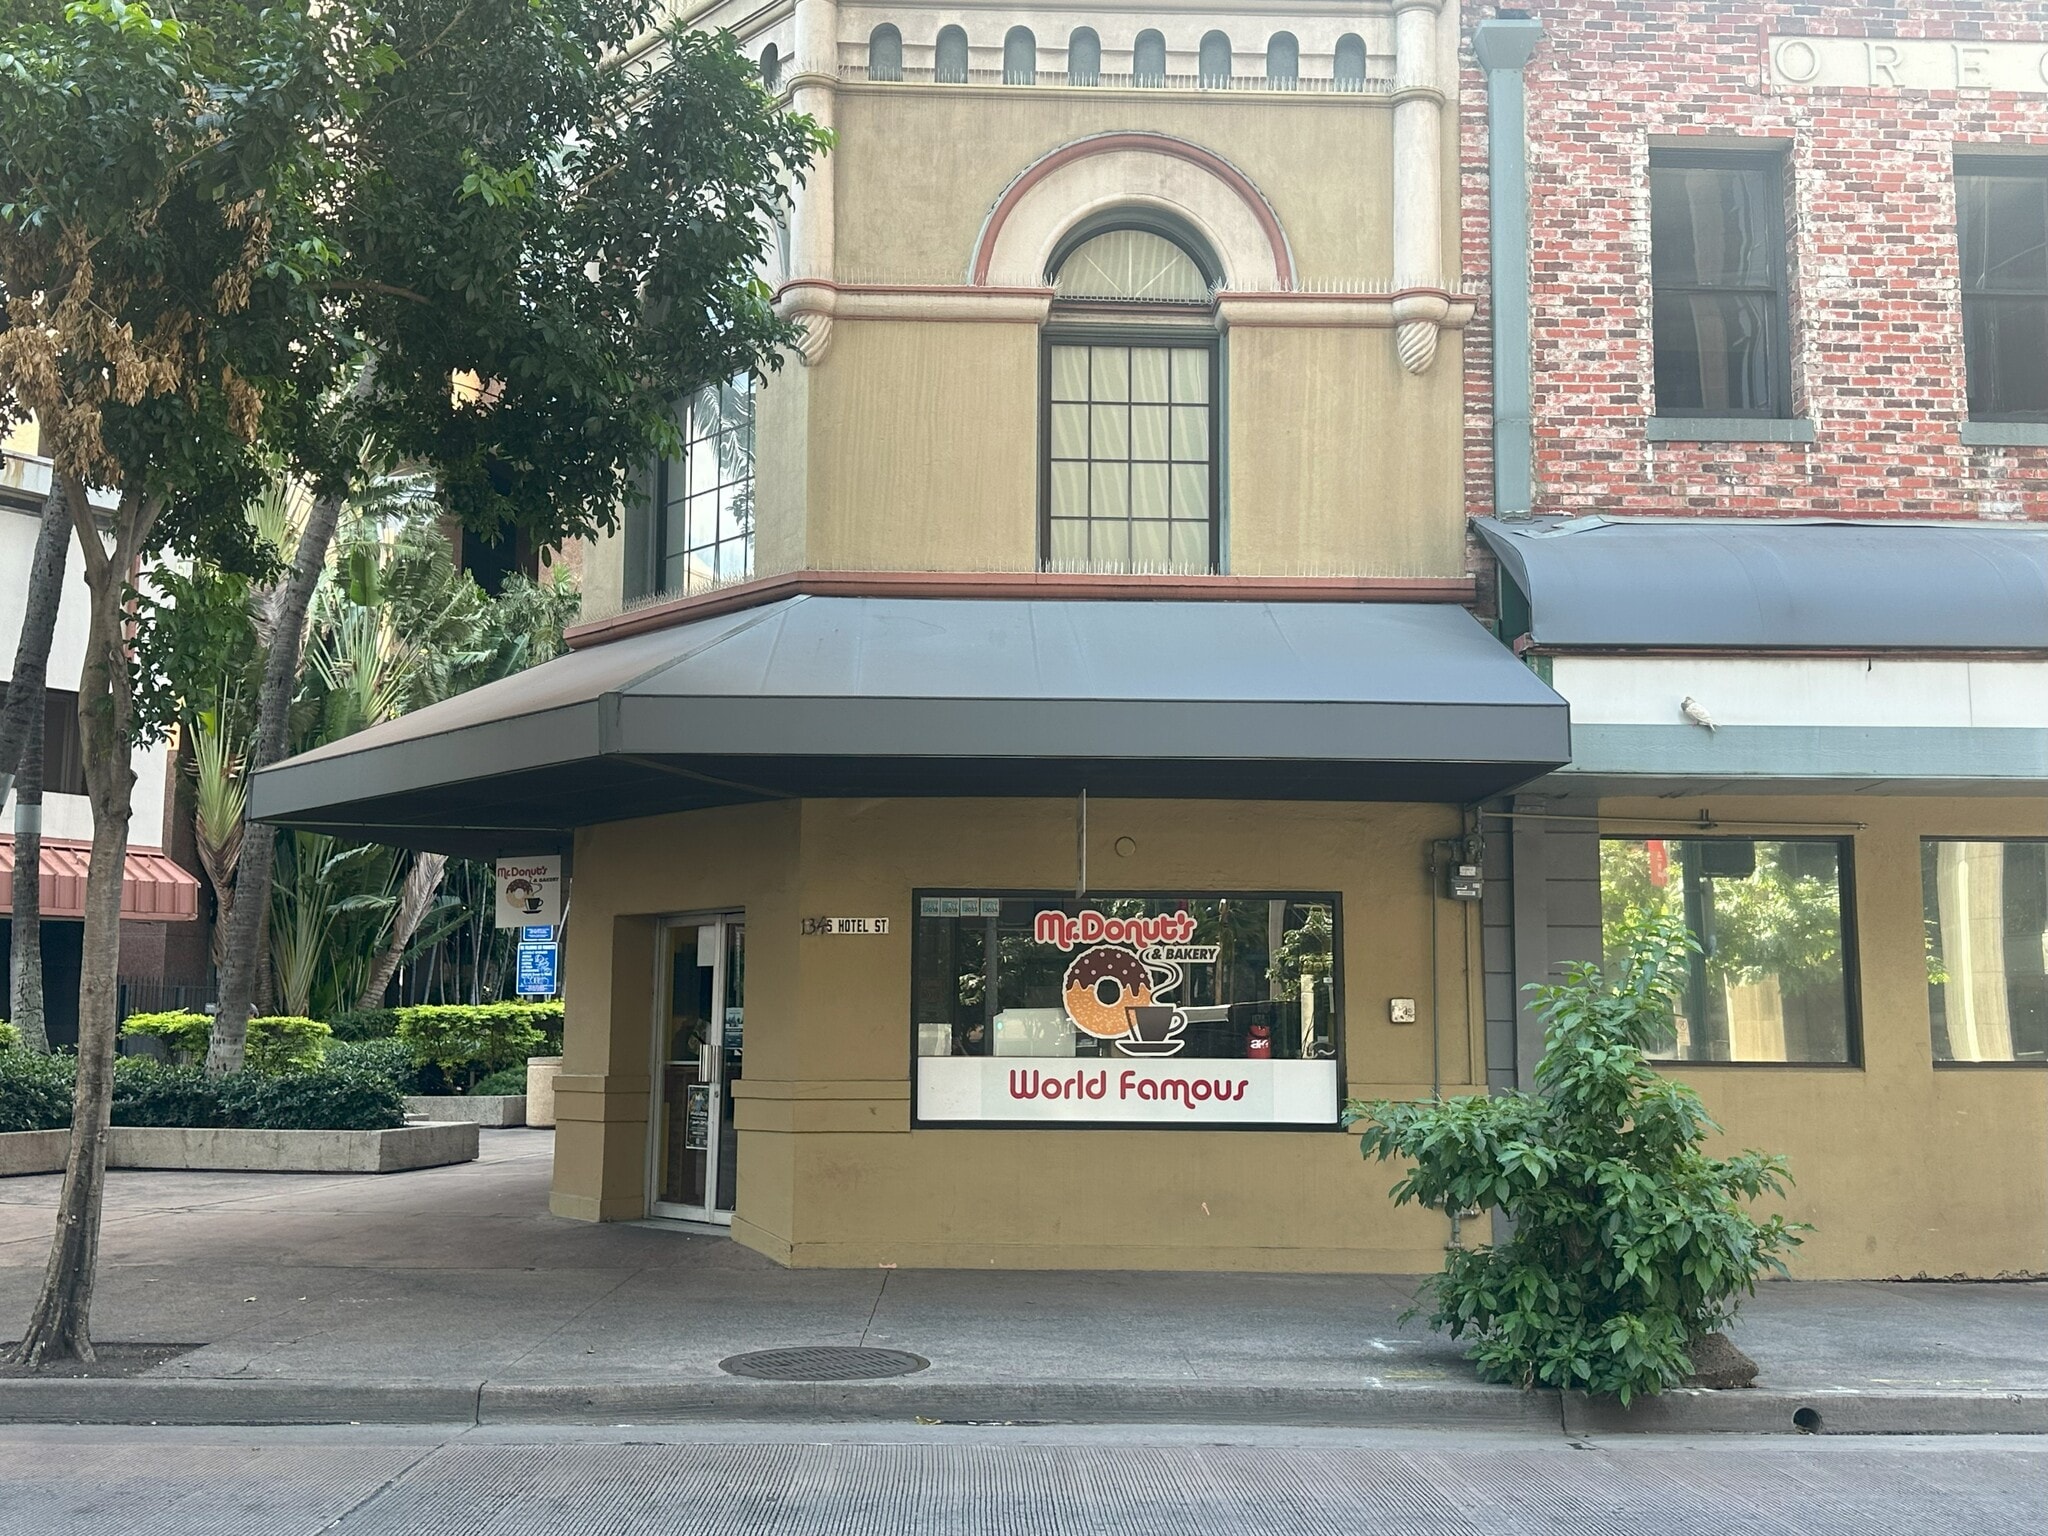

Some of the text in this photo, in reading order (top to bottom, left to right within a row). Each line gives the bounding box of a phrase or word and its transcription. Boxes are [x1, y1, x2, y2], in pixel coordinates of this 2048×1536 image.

[1776, 39, 2048, 89] ORE
[838, 919, 869, 932] HOTEL
[874, 919, 886, 932] ST
[1151, 948, 1217, 960] & BAKERY
[1010, 1069, 1249, 1110] World Famous
